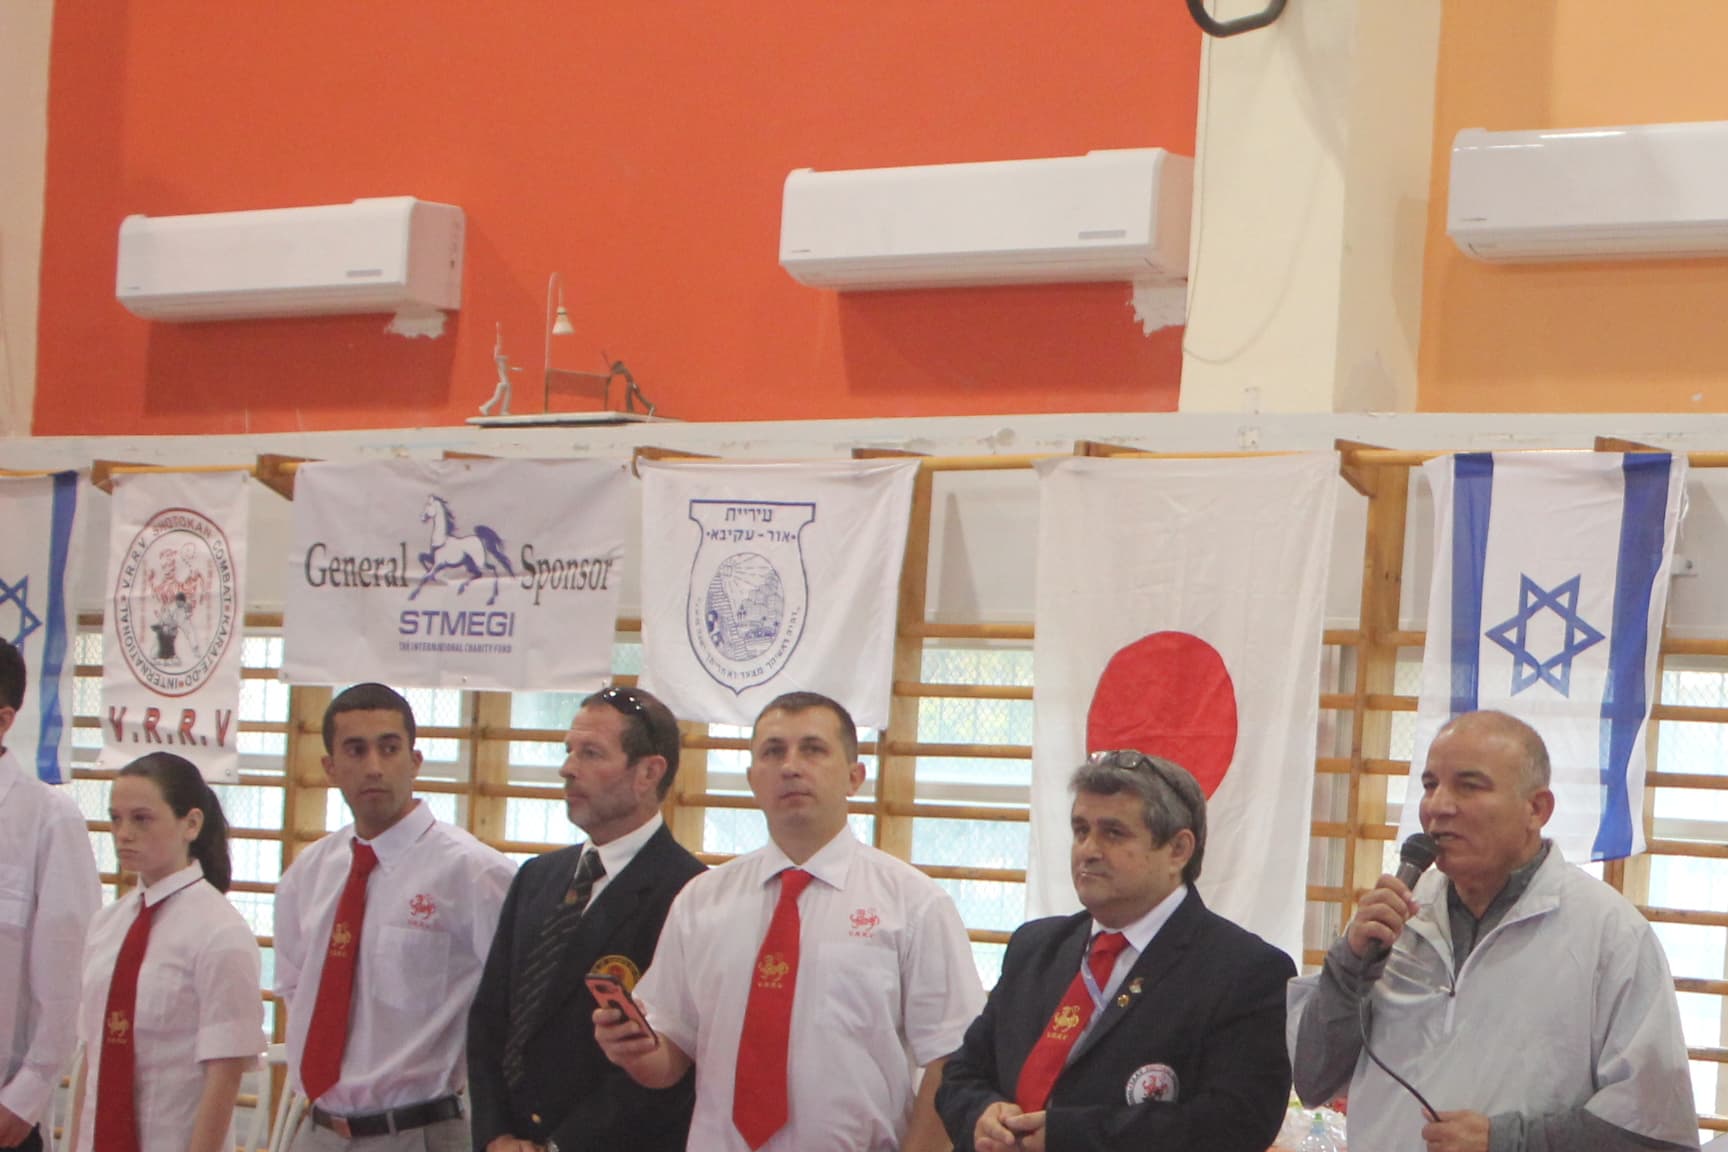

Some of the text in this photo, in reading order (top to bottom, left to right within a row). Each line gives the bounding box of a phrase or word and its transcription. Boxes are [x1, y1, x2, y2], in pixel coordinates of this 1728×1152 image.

[212, 539, 232, 604] COMBAT
[304, 542, 614, 606] General Sponsor
[398, 610, 515, 638] STMEGI
[108, 705, 232, 748] V.R.R.V
